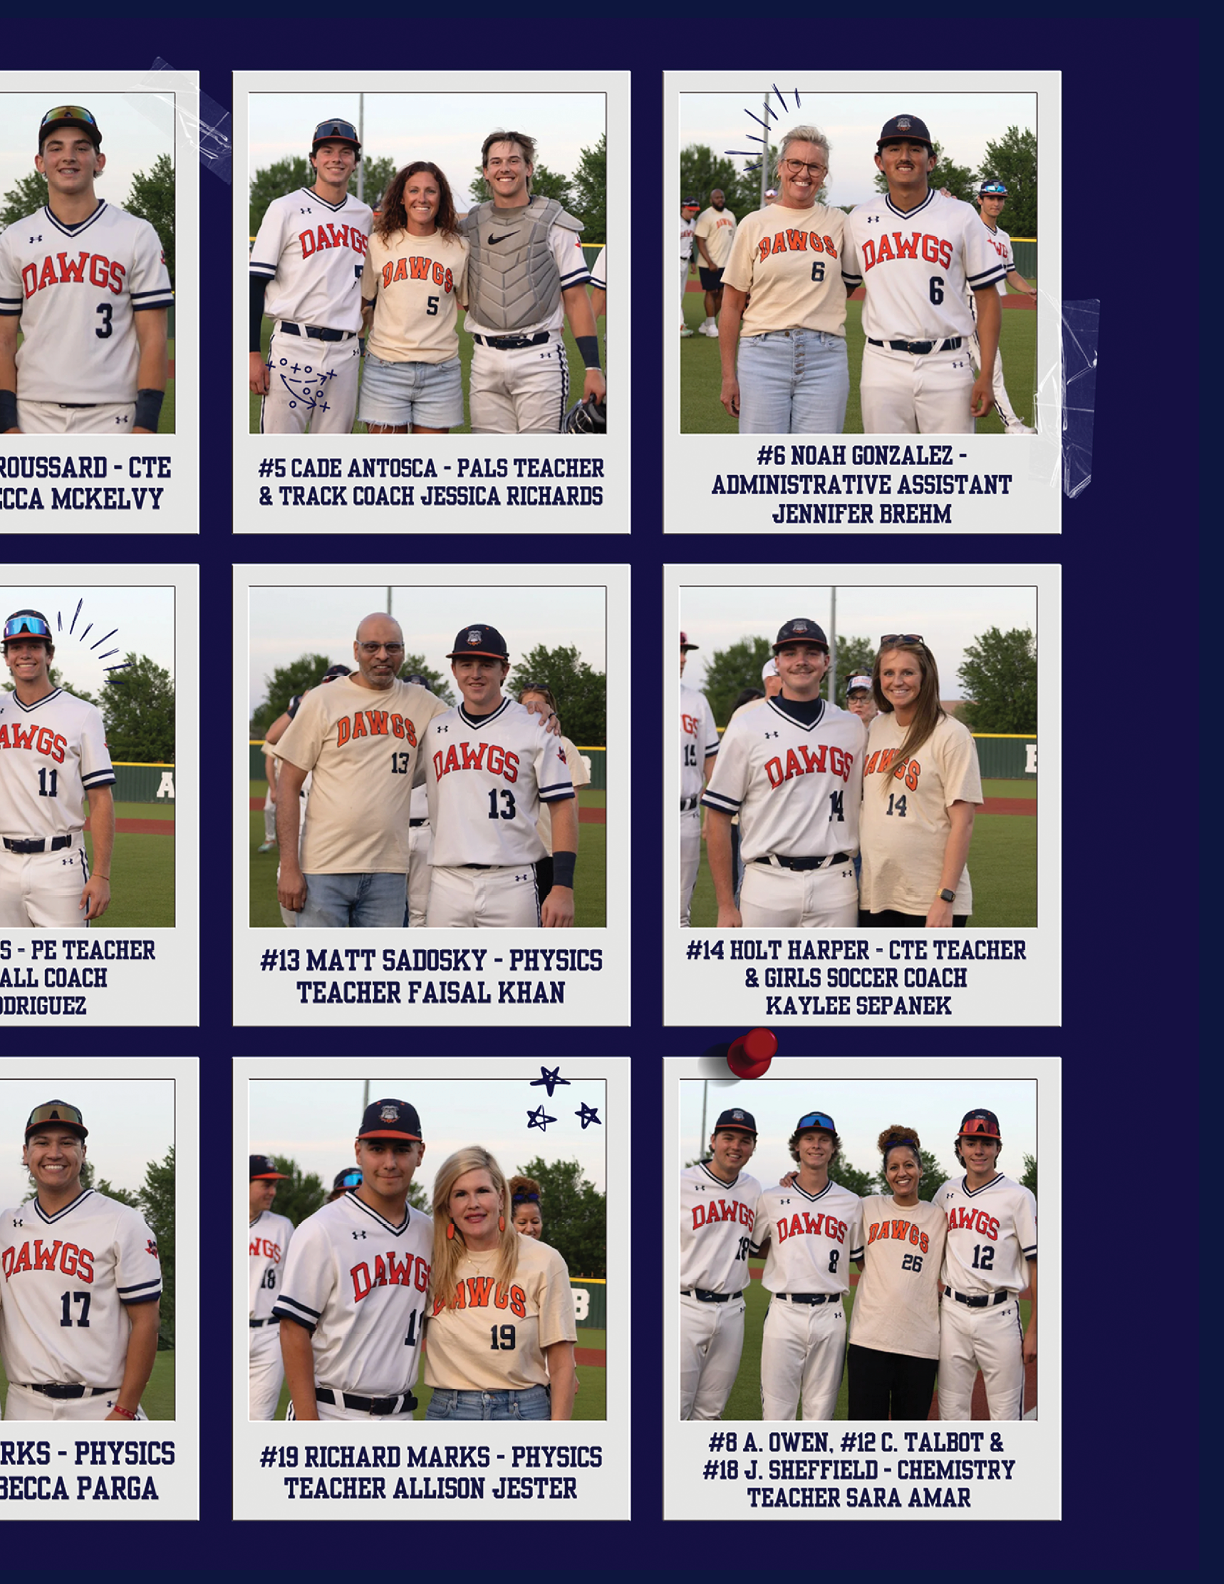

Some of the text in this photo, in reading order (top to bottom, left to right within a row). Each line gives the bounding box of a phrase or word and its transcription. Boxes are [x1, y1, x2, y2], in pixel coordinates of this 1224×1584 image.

[861, 232, 953, 272] DAWGS
[22, 252, 126, 299] DAWGS
[382, 256, 453, 294] DAWGS
[811, 261, 825, 282] 6
[426, 296, 440, 316] 5
[38, 767, 57, 797] 11
[764, 745, 854, 789] DAWGS
[488, 789, 516, 819] 13
[886, 793, 907, 817] 14
[776, 1212, 848, 1245] DAWGS
[901, 1254, 923, 1272] 26
[60, 1291, 90, 1327] 17
[490, 1324, 516, 1350] 19
